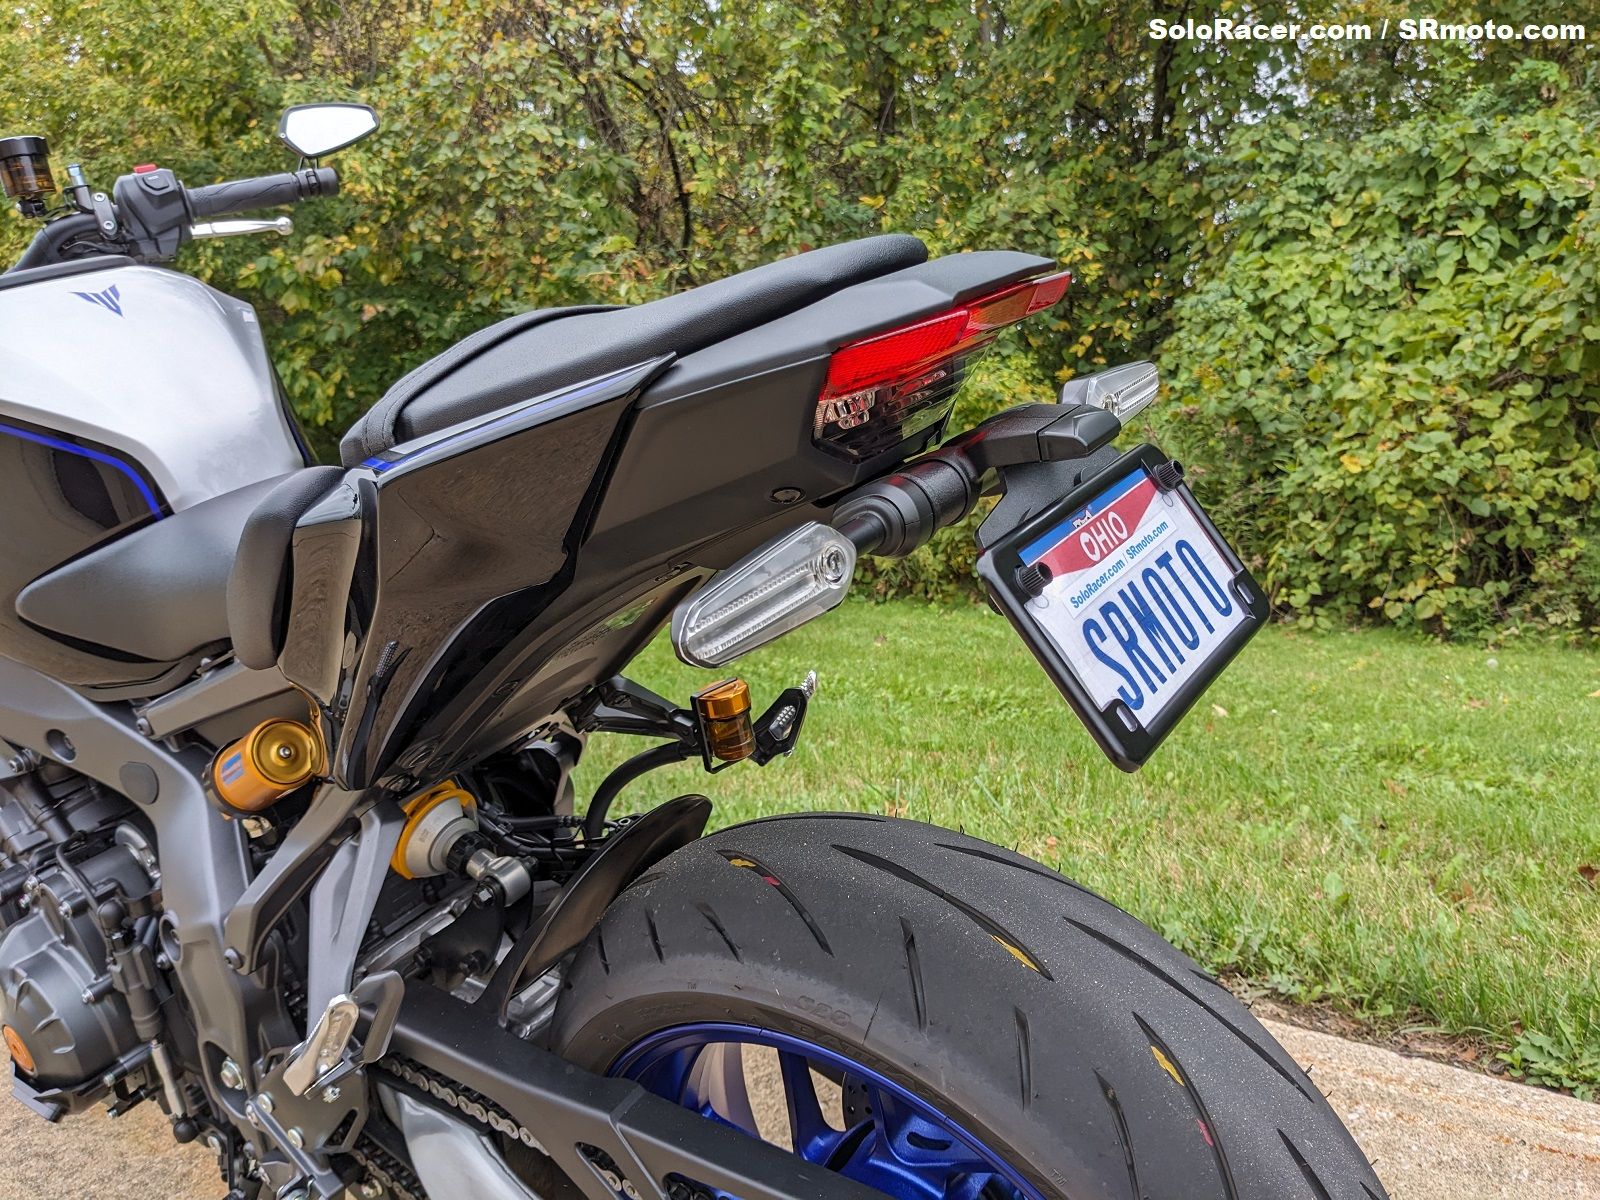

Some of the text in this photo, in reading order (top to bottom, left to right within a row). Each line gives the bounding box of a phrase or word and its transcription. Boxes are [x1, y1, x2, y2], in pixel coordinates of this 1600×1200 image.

[1070, 558, 1125, 608] SoloRacer.com
[1126, 520, 1169, 559] SRmoto.com
[1080, 511, 1127, 561] OHIO
[1082, 539, 1232, 711] SRMOTO
